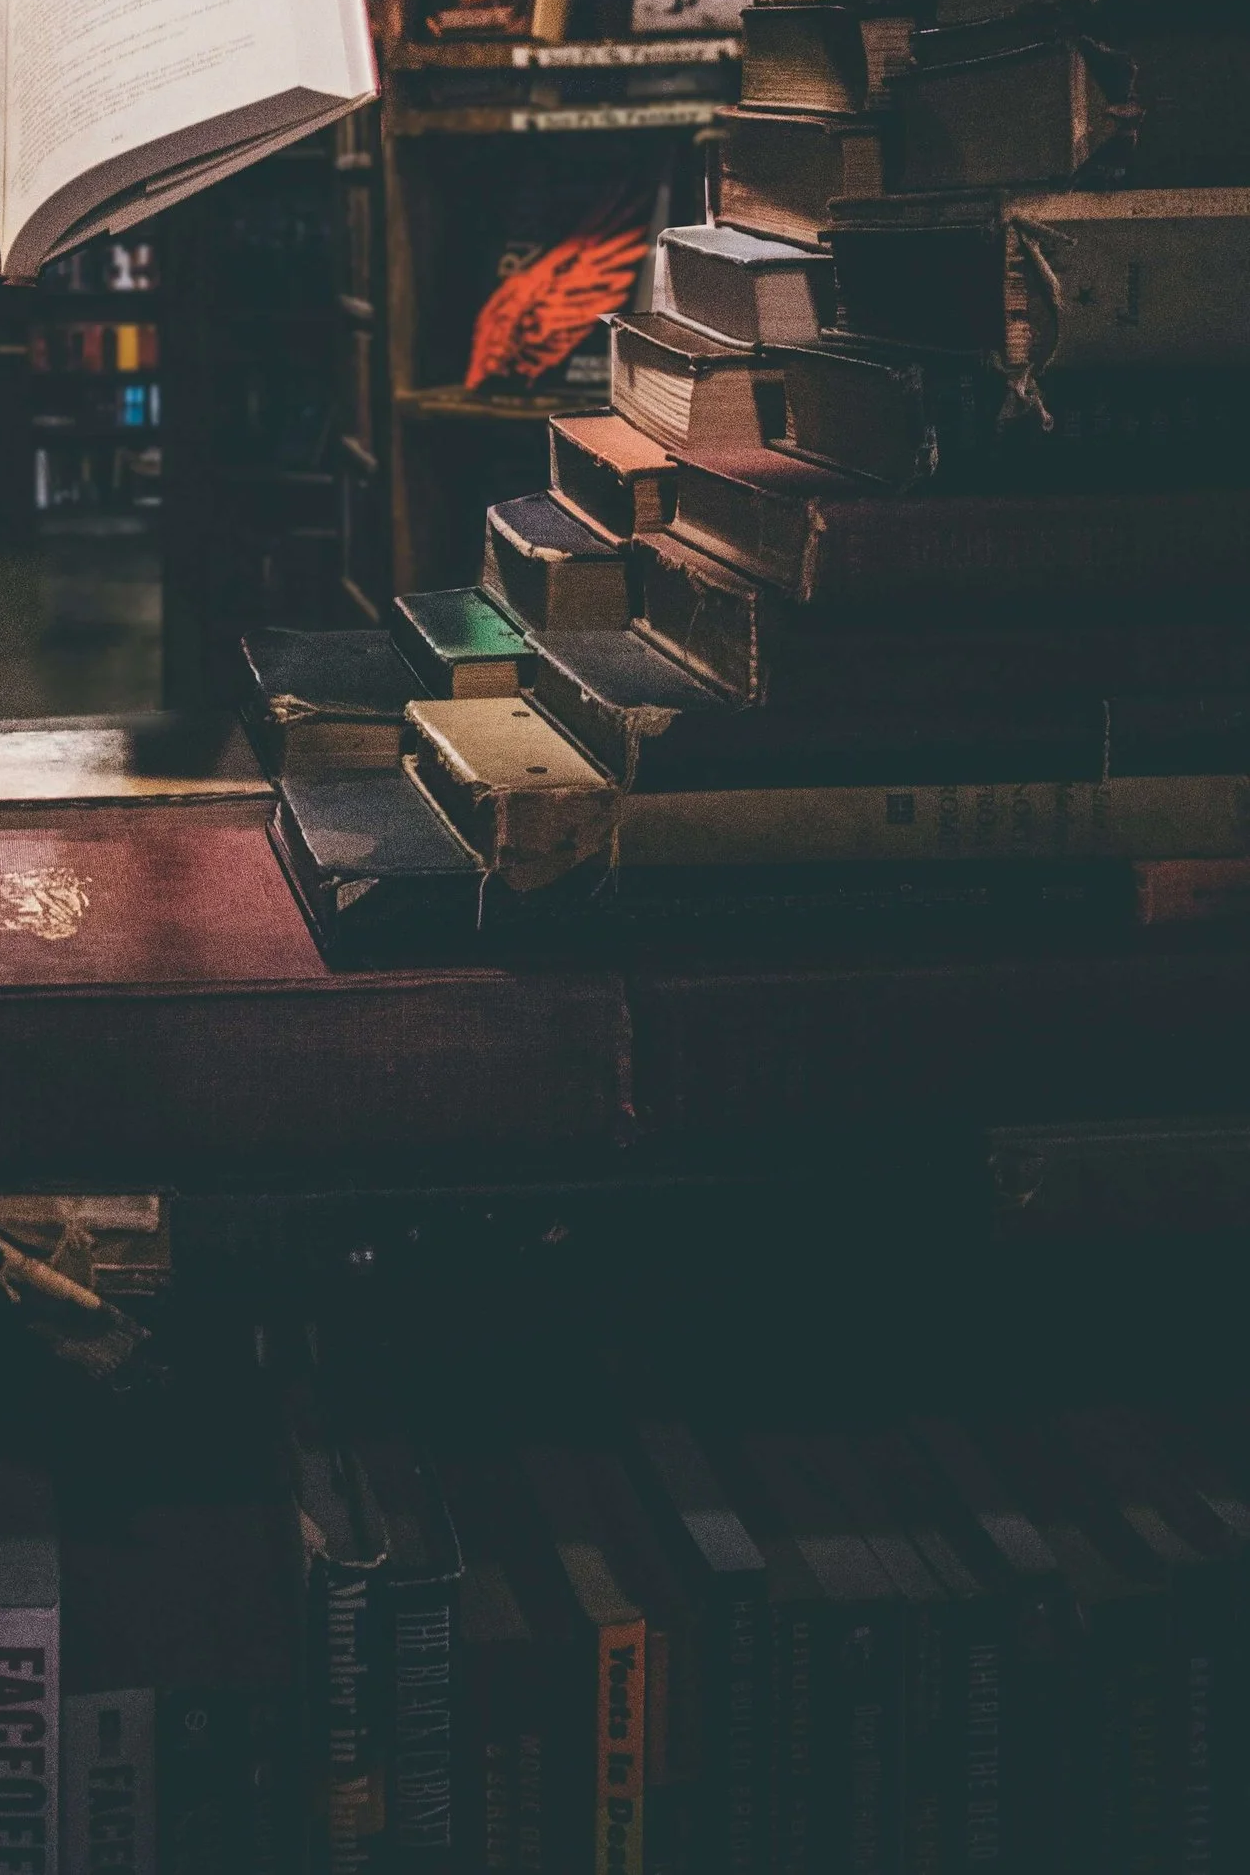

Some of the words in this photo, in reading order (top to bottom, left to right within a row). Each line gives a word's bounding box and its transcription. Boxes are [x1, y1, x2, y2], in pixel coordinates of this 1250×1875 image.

[326, 1578, 369, 1715] Murder
[395, 1605, 450, 1654] THE
[395, 1661, 450, 1745] BLACK
[965, 1642, 1001, 1738] INHERIT
[328, 1727, 369, 1762] in
[965, 1745, 1001, 1790] THE
[395, 1749, 450, 1849] CABINET
[965, 1799, 1001, 1861] DEAD
